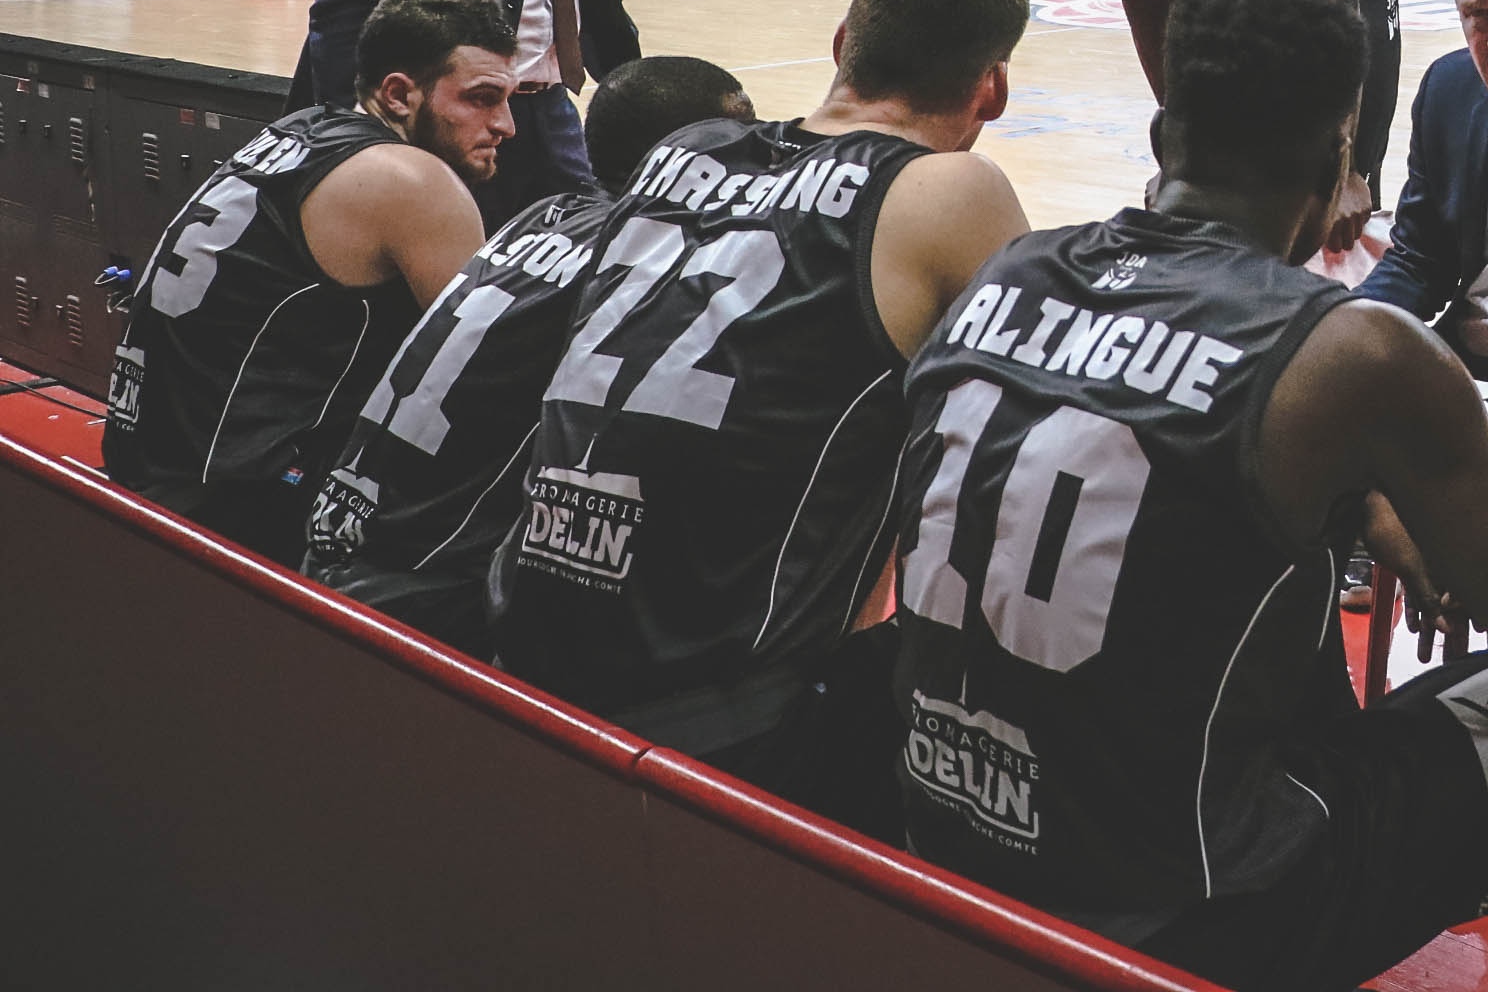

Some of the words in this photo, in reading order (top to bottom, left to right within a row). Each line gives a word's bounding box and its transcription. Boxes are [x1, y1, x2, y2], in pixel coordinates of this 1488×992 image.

[630, 144, 870, 219] CHASSING
[1116, 253, 1148, 269] JDA
[542, 215, 786, 431] 22
[946, 283, 1244, 414] ALINGUE
[107, 372, 141, 415] ELIN
[528, 500, 633, 568] DELIN
[902, 377, 1152, 674] 10
[908, 728, 1031, 825] DELIN
